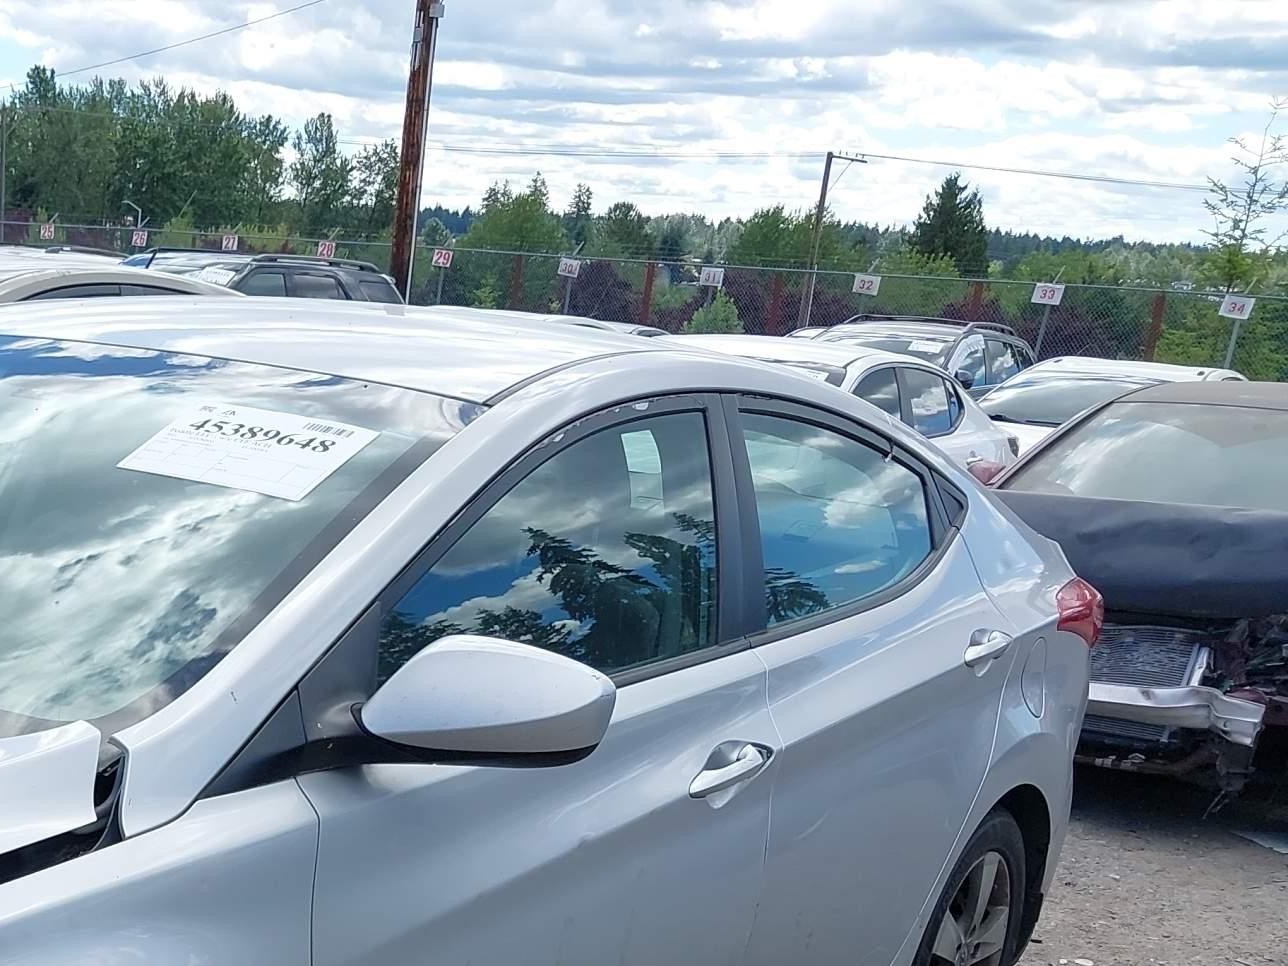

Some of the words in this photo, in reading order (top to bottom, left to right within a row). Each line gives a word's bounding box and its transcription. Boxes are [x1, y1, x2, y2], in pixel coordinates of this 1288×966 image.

[41, 225, 53, 239] 25
[133, 232, 145, 246] 26
[224, 236, 236, 248] 27
[319, 243, 333, 257] 28
[433, 251, 450, 265] 29
[858, 279, 873, 291] 32
[1039, 288, 1055, 300] 33
[1227, 302, 1245, 314] 34
[188, 418, 337, 453] 45389648
